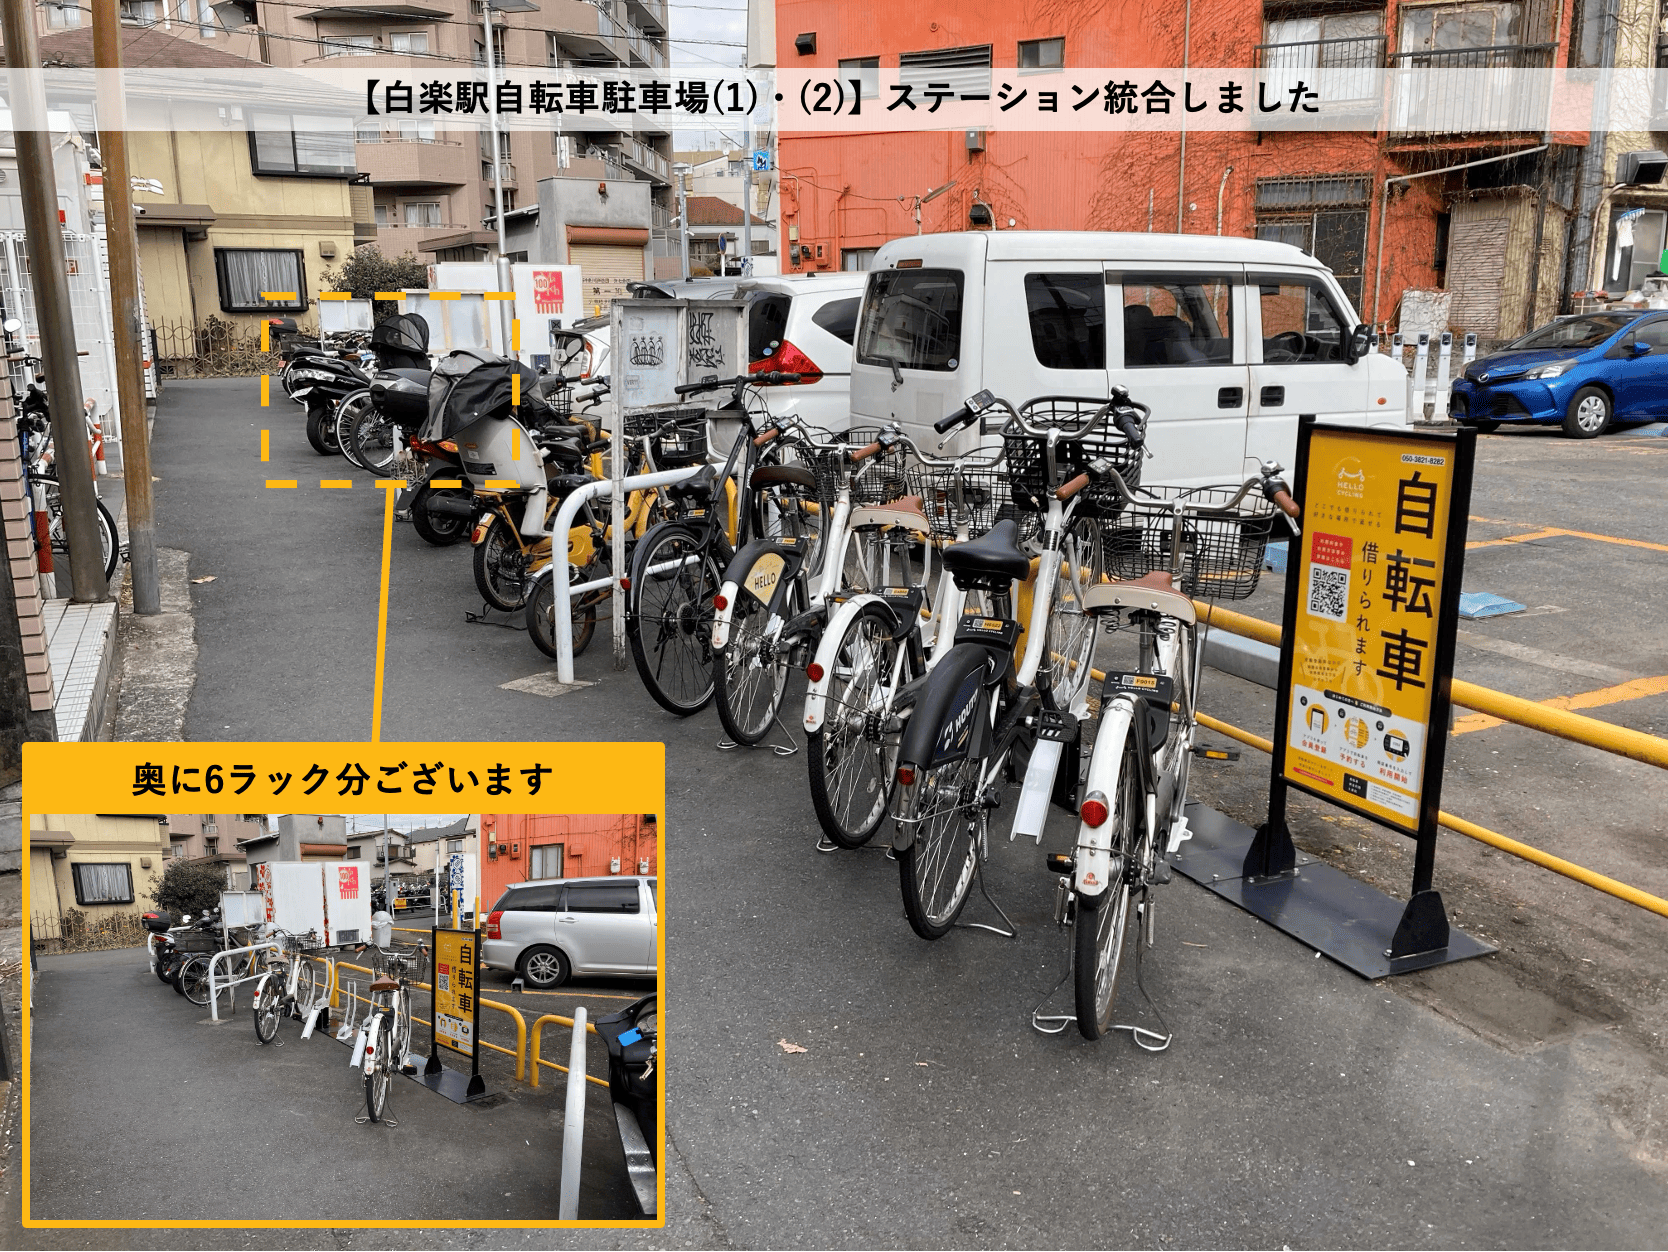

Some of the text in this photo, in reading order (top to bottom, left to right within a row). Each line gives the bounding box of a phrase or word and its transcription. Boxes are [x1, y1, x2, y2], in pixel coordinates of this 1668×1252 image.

[1401, 454, 1445, 466] 050-3821-8282
[1336, 490, 1364, 499] CYCLING
[1337, 482, 1365, 491] HELLO
[755, 572, 776, 590] HELLO
[1376, 470, 1438, 692] 自転車
[1353, 541, 1379, 676] 借りられます
[1340, 753, 1366, 768] 予約する
[458, 943, 473, 1013] 自転車
